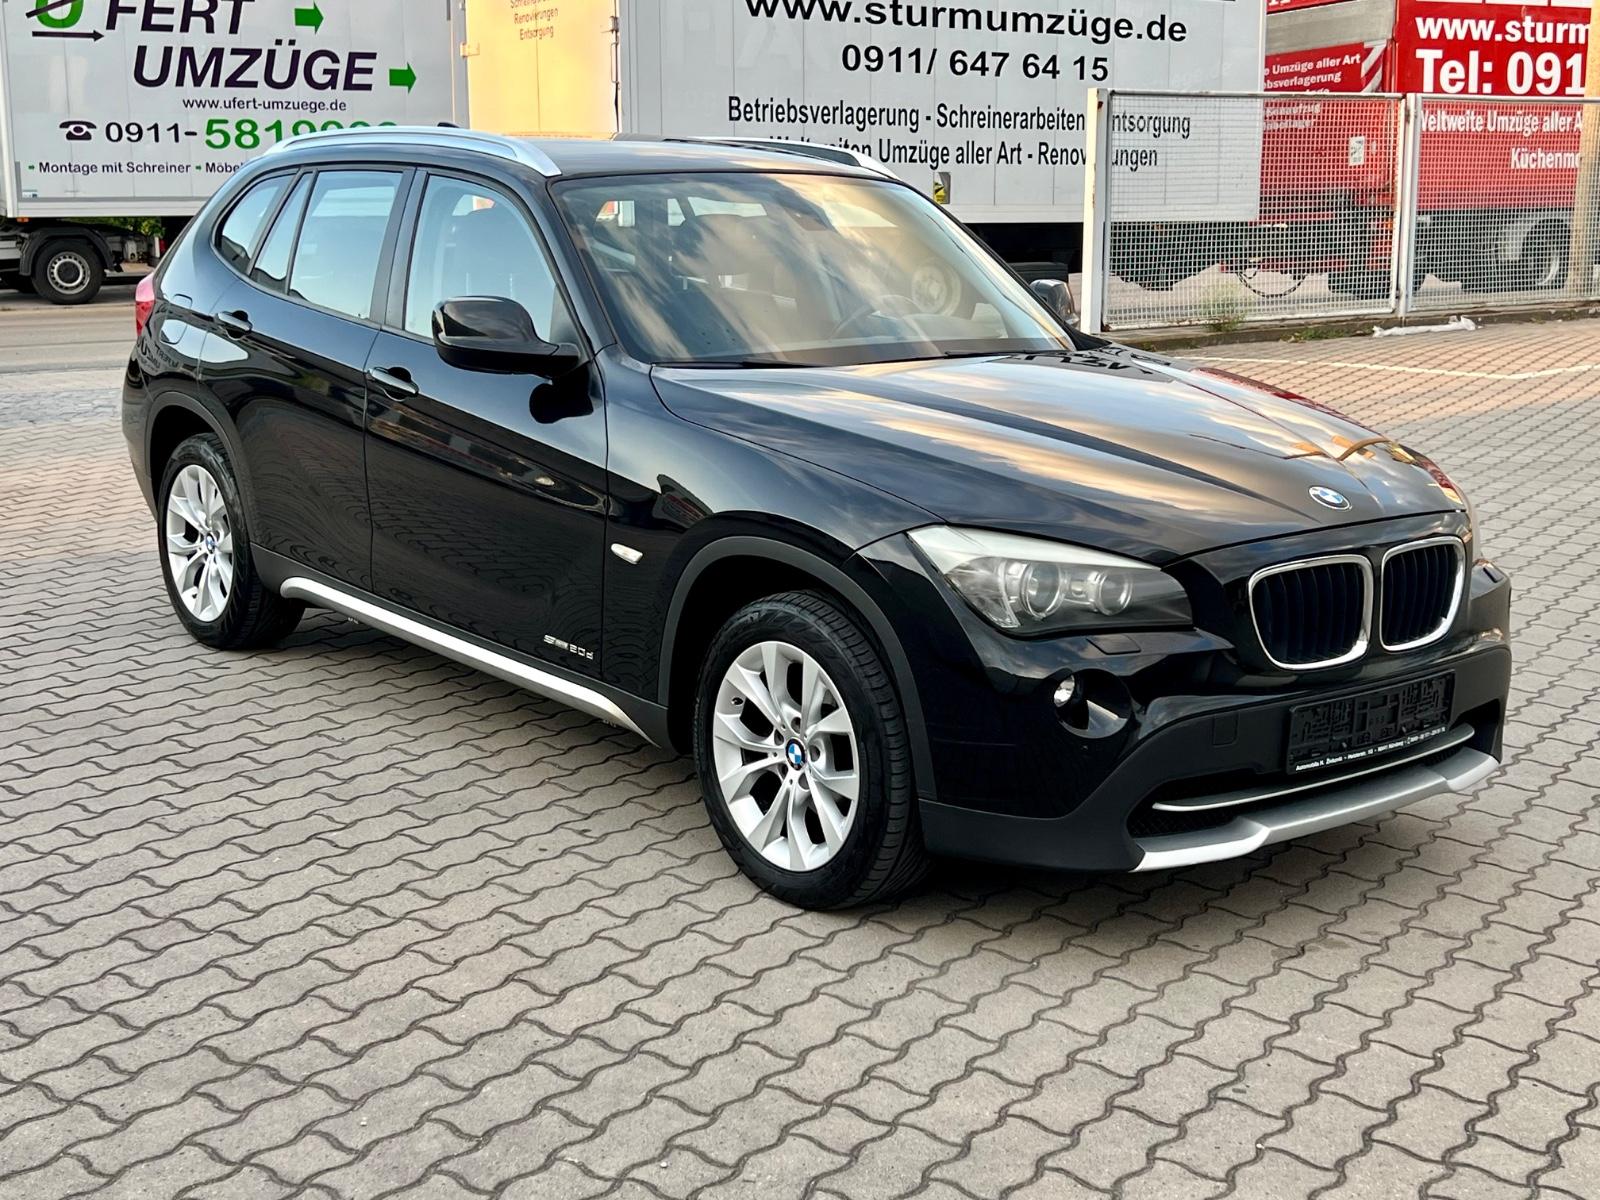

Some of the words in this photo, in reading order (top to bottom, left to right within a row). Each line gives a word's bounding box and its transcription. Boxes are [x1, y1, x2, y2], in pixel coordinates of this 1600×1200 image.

[746, 0, 1187, 45] www.sturmumzüge.de
[133, 38, 377, 91] UMZÜGE
[841, 45, 938, 74] 0911/
[950, 50, 1010, 77] 647
[1022, 53, 1060, 80] 64
[1072, 55, 1108, 82] 15
[1272, 61, 1314, 75] Umzüge
[1315, 57, 1341, 69] aller
[1343, 53, 1361, 65] Art
[1416, 49, 1493, 94] Tel:
[182, 96, 347, 112] www.ufert-umzuege.de
[728, 95, 919, 133] Betriebsverlagerung
[936, 102, 1085, 131] Schreinerarbeiten
[1111, 110, 1191, 139] ntsorgung
[1487, 110, 1539, 137] Umzüge
[1542, 111, 1571, 133] aller
[39, 162, 98, 176] Montage
[102, 162, 123, 173] mit
[126, 162, 191, 174] Schreiner
[205, 162, 244, 174] Möbe
[878, 138, 950, 170] Umzüge
[955, 140, 992, 165] aller
[996, 141, 1022, 165] Art
